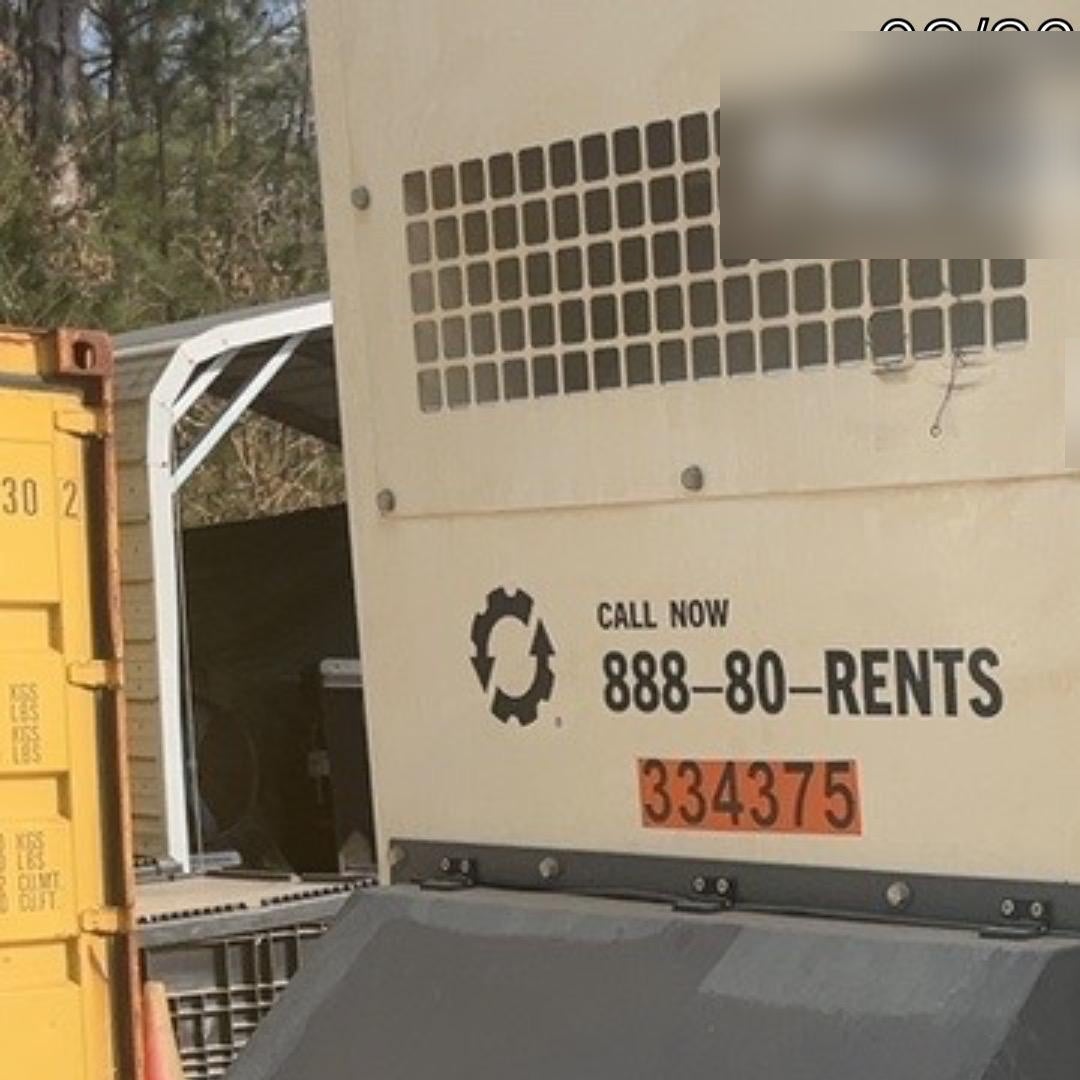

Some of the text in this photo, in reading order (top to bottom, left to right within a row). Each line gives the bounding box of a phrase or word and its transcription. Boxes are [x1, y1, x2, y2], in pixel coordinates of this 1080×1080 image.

[598, 599, 729, 630] CALL NOW
[642, 758, 858, 829] 334375
